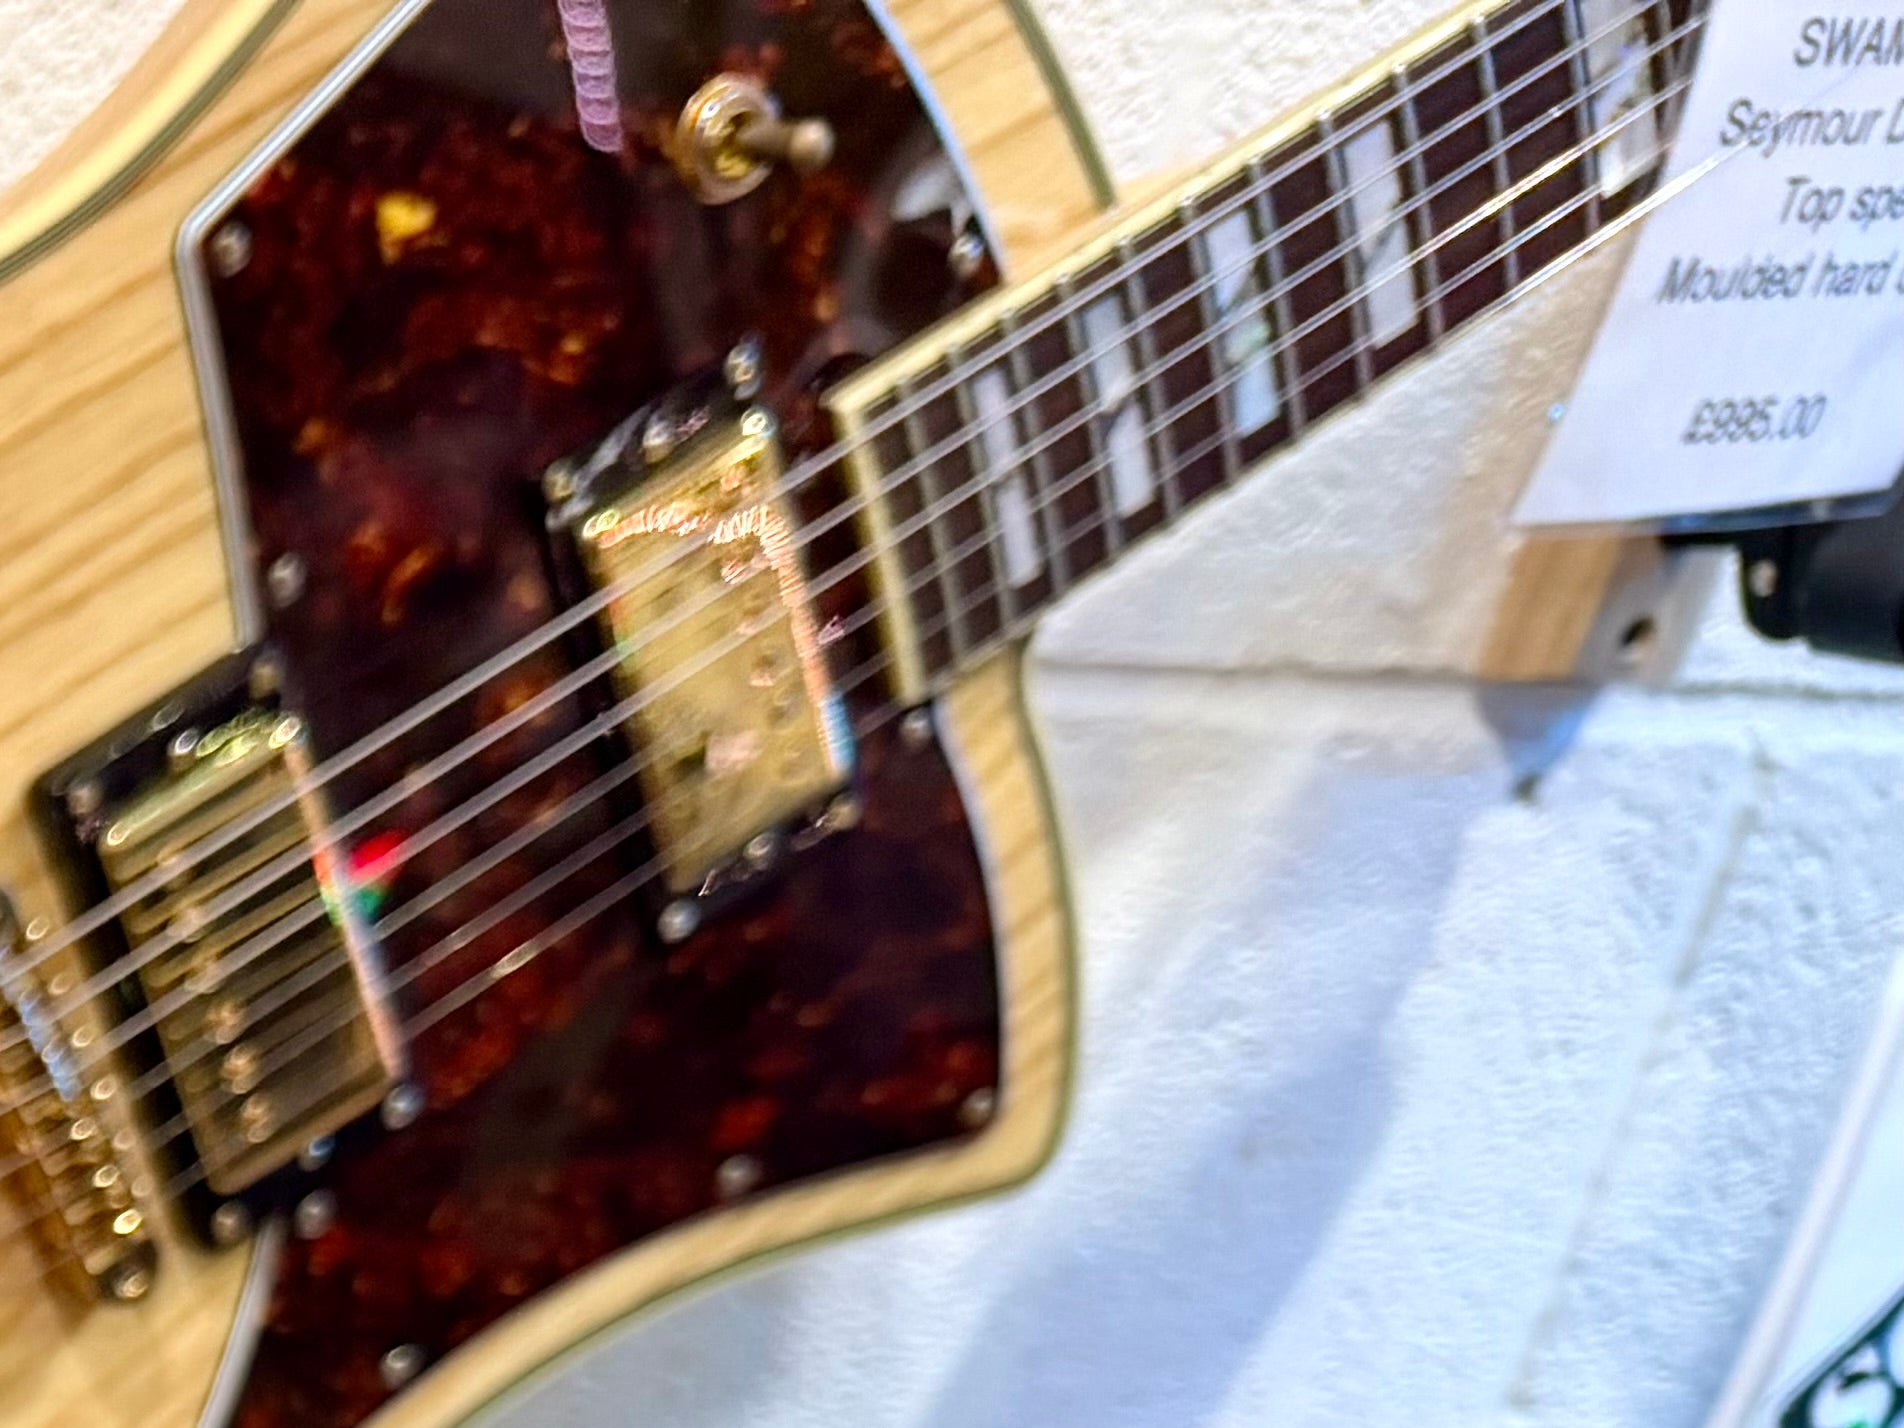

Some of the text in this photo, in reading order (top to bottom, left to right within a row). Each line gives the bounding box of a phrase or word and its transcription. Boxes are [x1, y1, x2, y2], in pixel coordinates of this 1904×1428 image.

[1719, 96, 1886, 158] Seymour
[1780, 175, 1844, 234] Top
[1658, 254, 1814, 303] Moulded
[1811, 251, 1898, 298] hard
